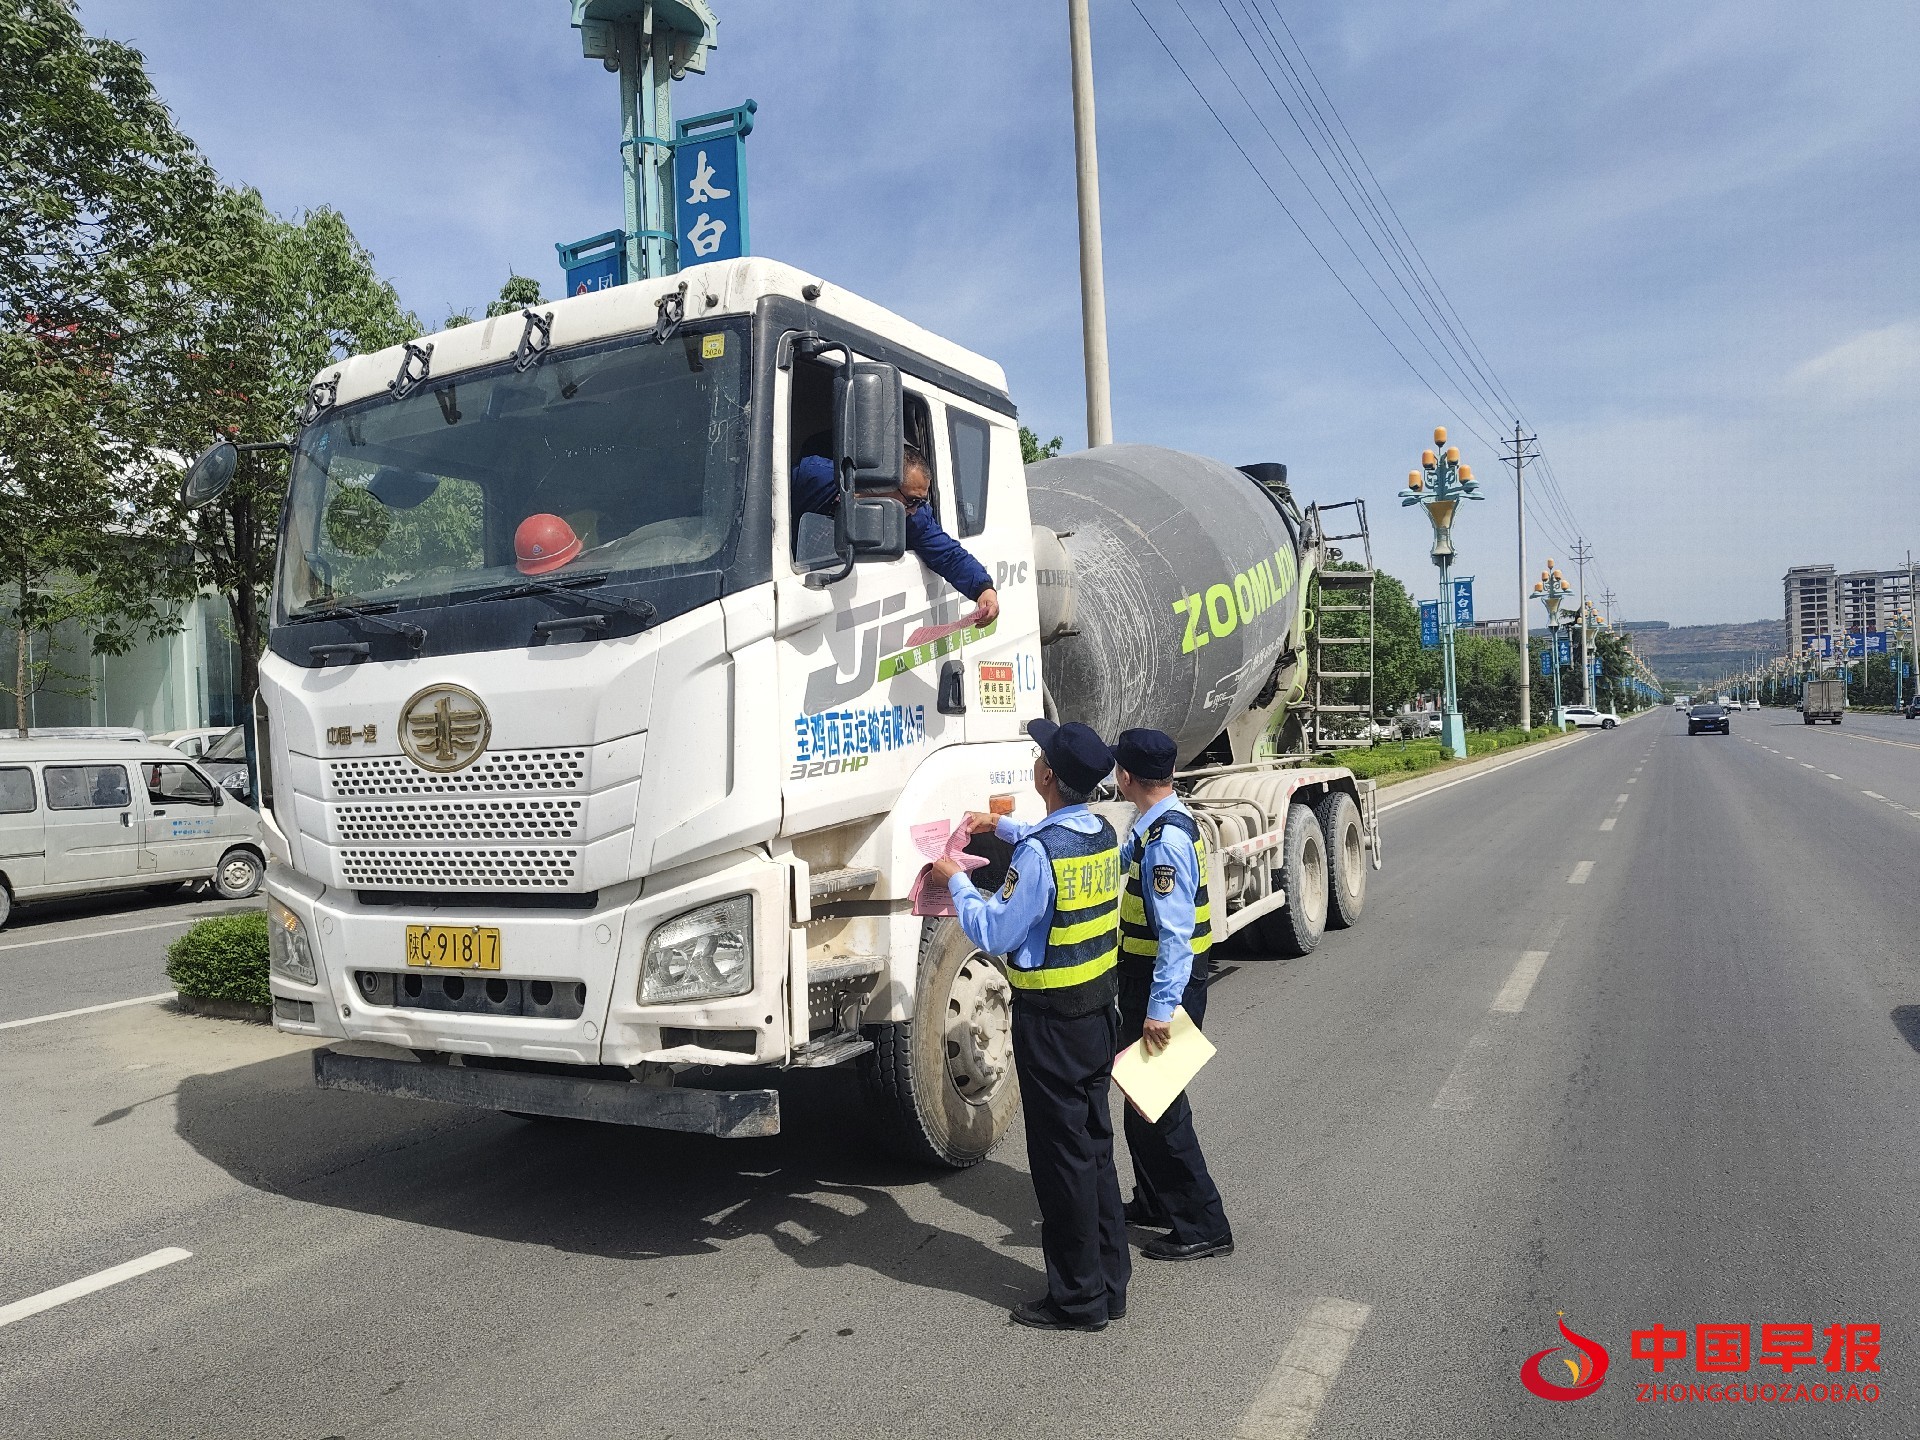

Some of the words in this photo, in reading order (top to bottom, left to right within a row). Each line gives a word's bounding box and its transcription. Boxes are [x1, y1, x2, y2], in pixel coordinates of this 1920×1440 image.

[686, 151, 731, 257] 太白
[1457, 585, 1470, 620] 太白酒
